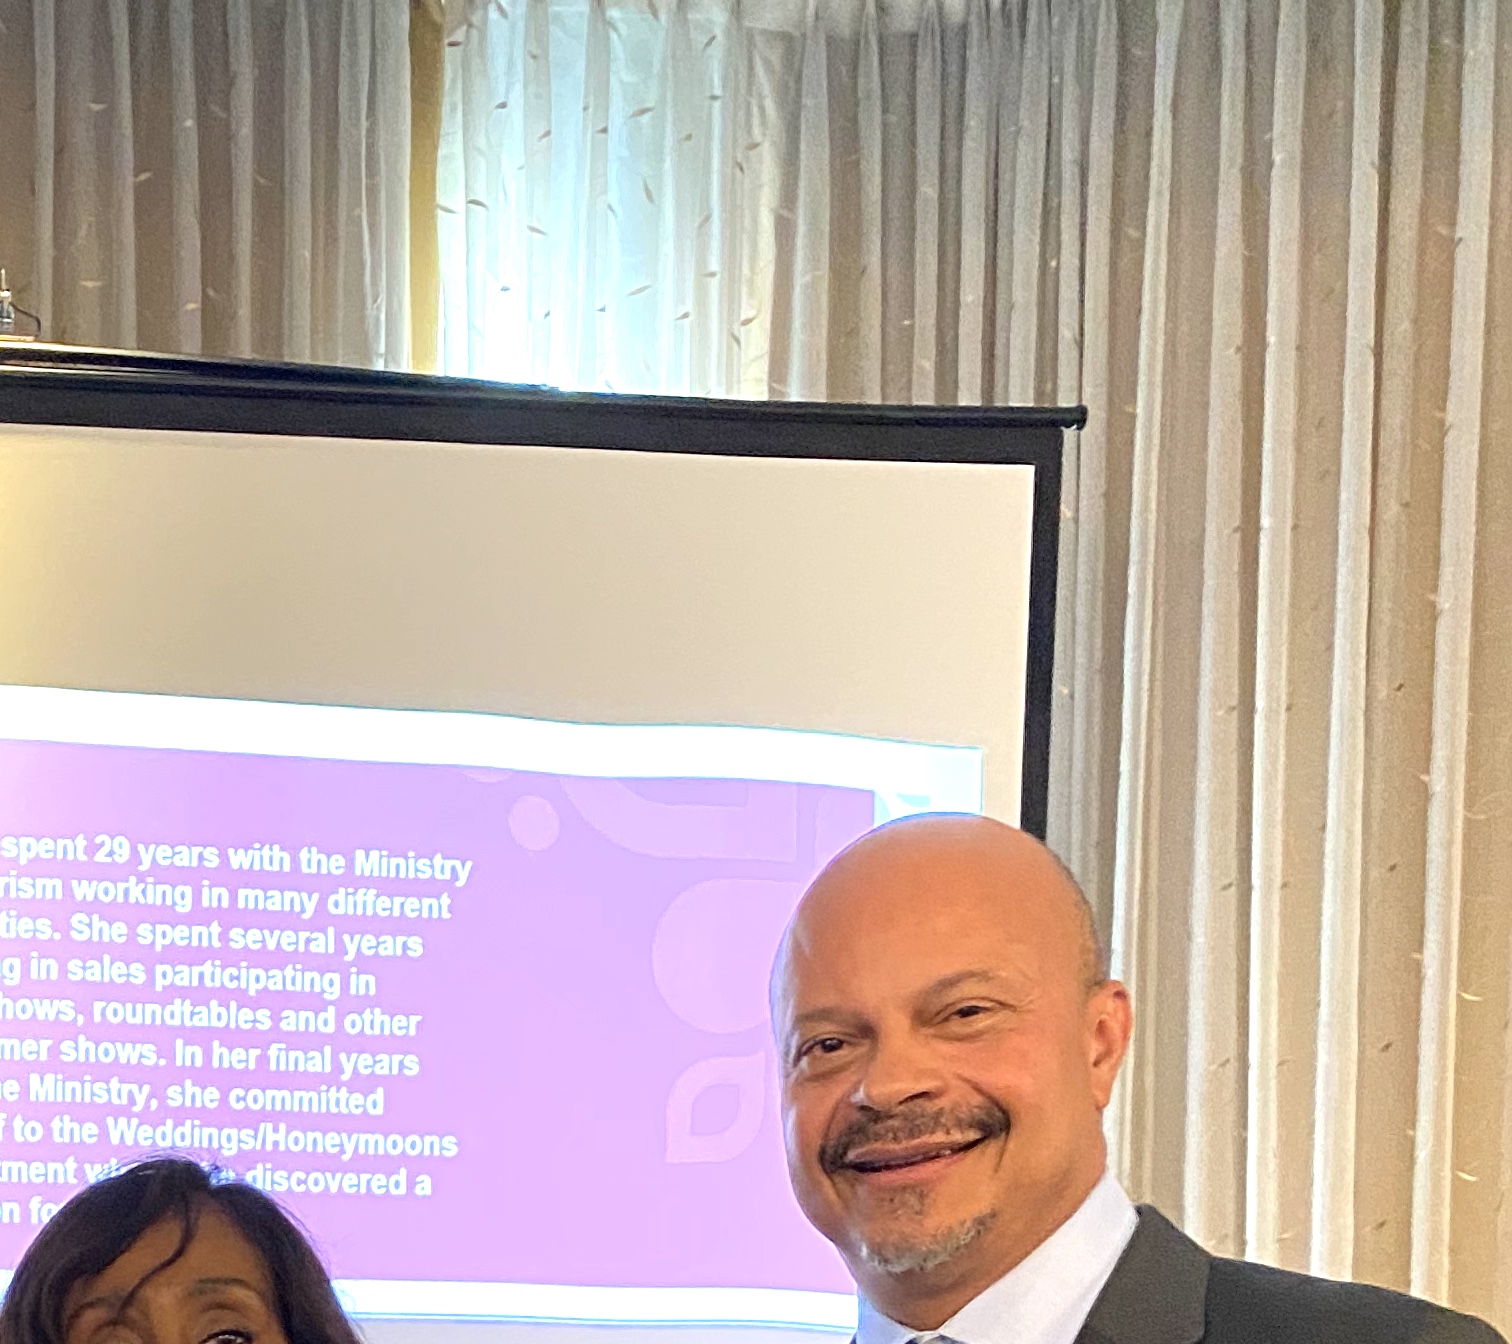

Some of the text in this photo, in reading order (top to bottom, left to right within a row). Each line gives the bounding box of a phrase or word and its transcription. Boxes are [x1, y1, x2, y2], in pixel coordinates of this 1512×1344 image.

[0, 834, 87, 865] spent
[94, 835, 130, 863] 29
[138, 844, 219, 871] years
[228, 843, 290, 872] with
[299, 847, 345, 875] the
[355, 849, 472, 887] Ministry
[71, 876, 192, 913] working
[202, 880, 229, 908] in
[238, 889, 319, 919] many
[328, 887, 451, 919] different
[70, 913, 127, 943] She
[136, 920, 222, 952] spent
[229, 927, 334, 953] several
[343, 934, 423, 961] years
[29, 951, 59, 981] in
[67, 956, 146, 984] sales
[155, 960, 340, 1000] participating
[350, 967, 376, 995] in
[93, 998, 272, 1030] roundtables
[280, 1006, 335, 1033] and
[344, 1008, 422, 1036] other
[60, 1034, 166, 1066] shows.
[176, 1039, 202, 1067] In
[212, 1040, 261, 1070] her
[268, 1043, 331, 1073] final
[339, 1053, 419, 1081] years
[30, 1073, 158, 1112] Ministry,
[166, 1079, 220, 1108] she
[229, 1085, 384, 1115] committed
[13, 1114, 43, 1142] to
[51, 1115, 98, 1143] the
[107, 1117, 458, 1161] Weddings/Honeymoons
[245, 1163, 407, 1195] discovered
[414, 1175, 431, 1195] a
[30, 1194, 61, 1225] fo
